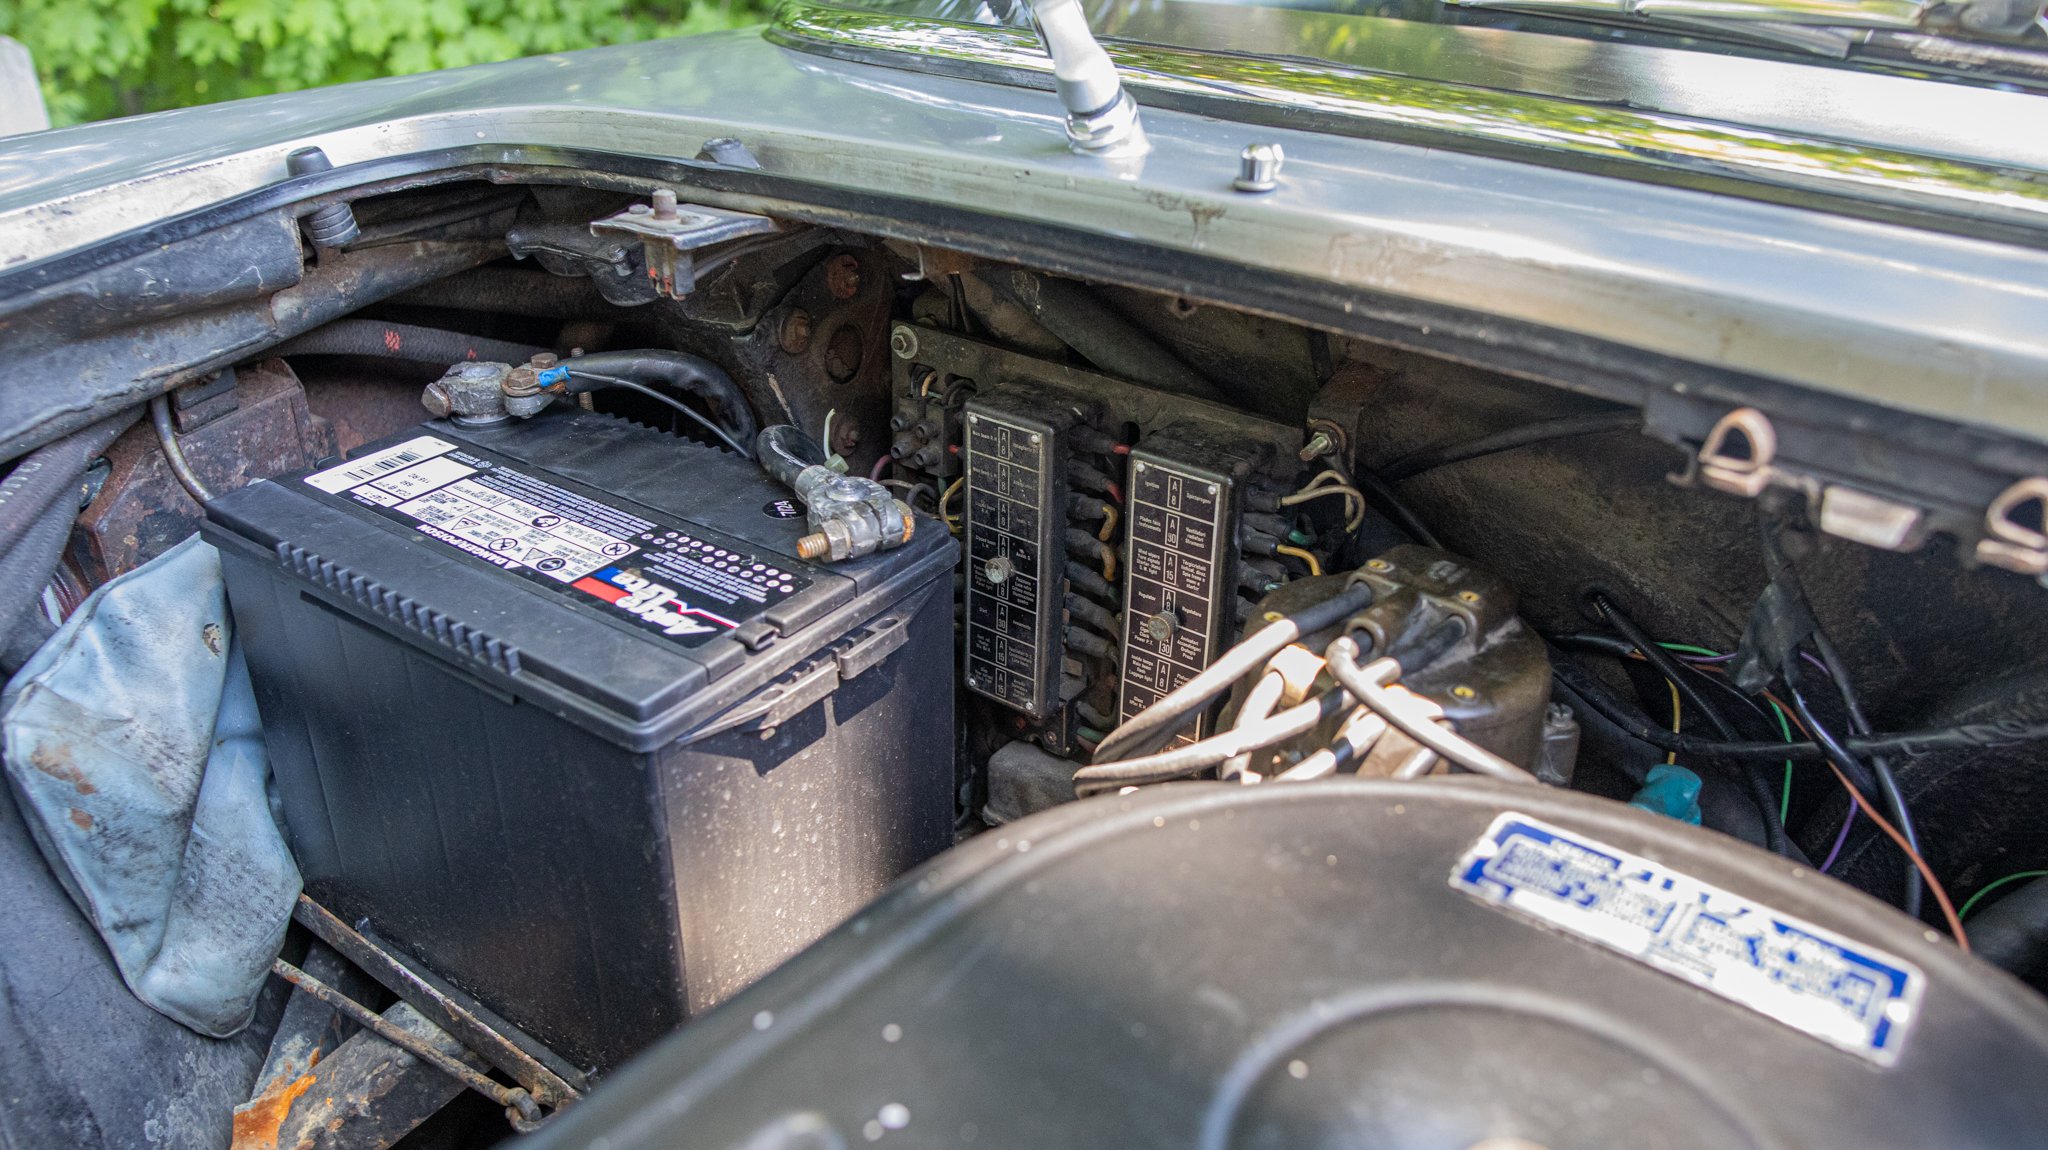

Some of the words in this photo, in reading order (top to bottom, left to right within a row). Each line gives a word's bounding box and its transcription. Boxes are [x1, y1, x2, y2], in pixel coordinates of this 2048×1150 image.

[1172, 481, 1177, 491] A
[395, 488, 411, 496] CCA
[1171, 495, 1176, 505] 8
[1170, 519, 1175, 529] A
[1167, 533, 1176, 543] 30
[1167, 556, 1173, 566] A
[1166, 570, 1173, 580] 15
[1166, 591, 1171, 601] A
[615, 593, 717, 635] Astro
[998, 618, 1005, 628] 30
[1161, 643, 1169, 653] 30
[998, 652, 1004, 661] 15
[1160, 665, 1165, 674] A
[1159, 678, 1164, 687] 8
[998, 684, 1003, 693] 15
